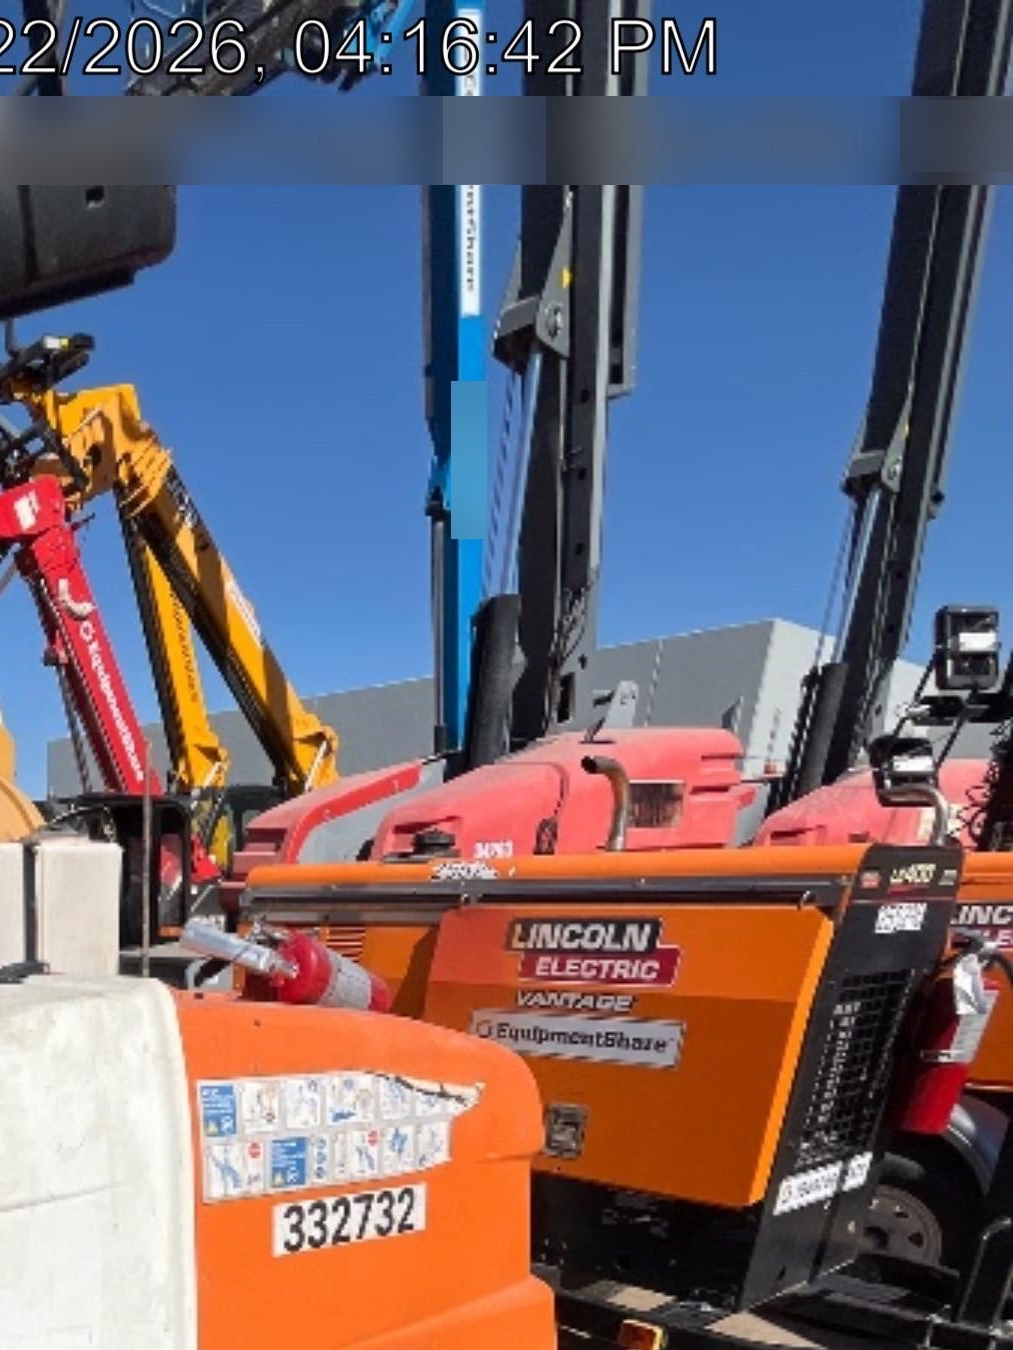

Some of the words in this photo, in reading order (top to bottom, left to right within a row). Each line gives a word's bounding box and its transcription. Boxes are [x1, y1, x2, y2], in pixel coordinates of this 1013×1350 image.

[512, 923, 651, 951] LINCOLN
[535, 956, 660, 979] ELECTRIC
[518, 990, 633, 1012] VANTAGE
[497, 1023, 666, 1052] EquipmentShare
[284, 1188, 414, 1252] 332732
